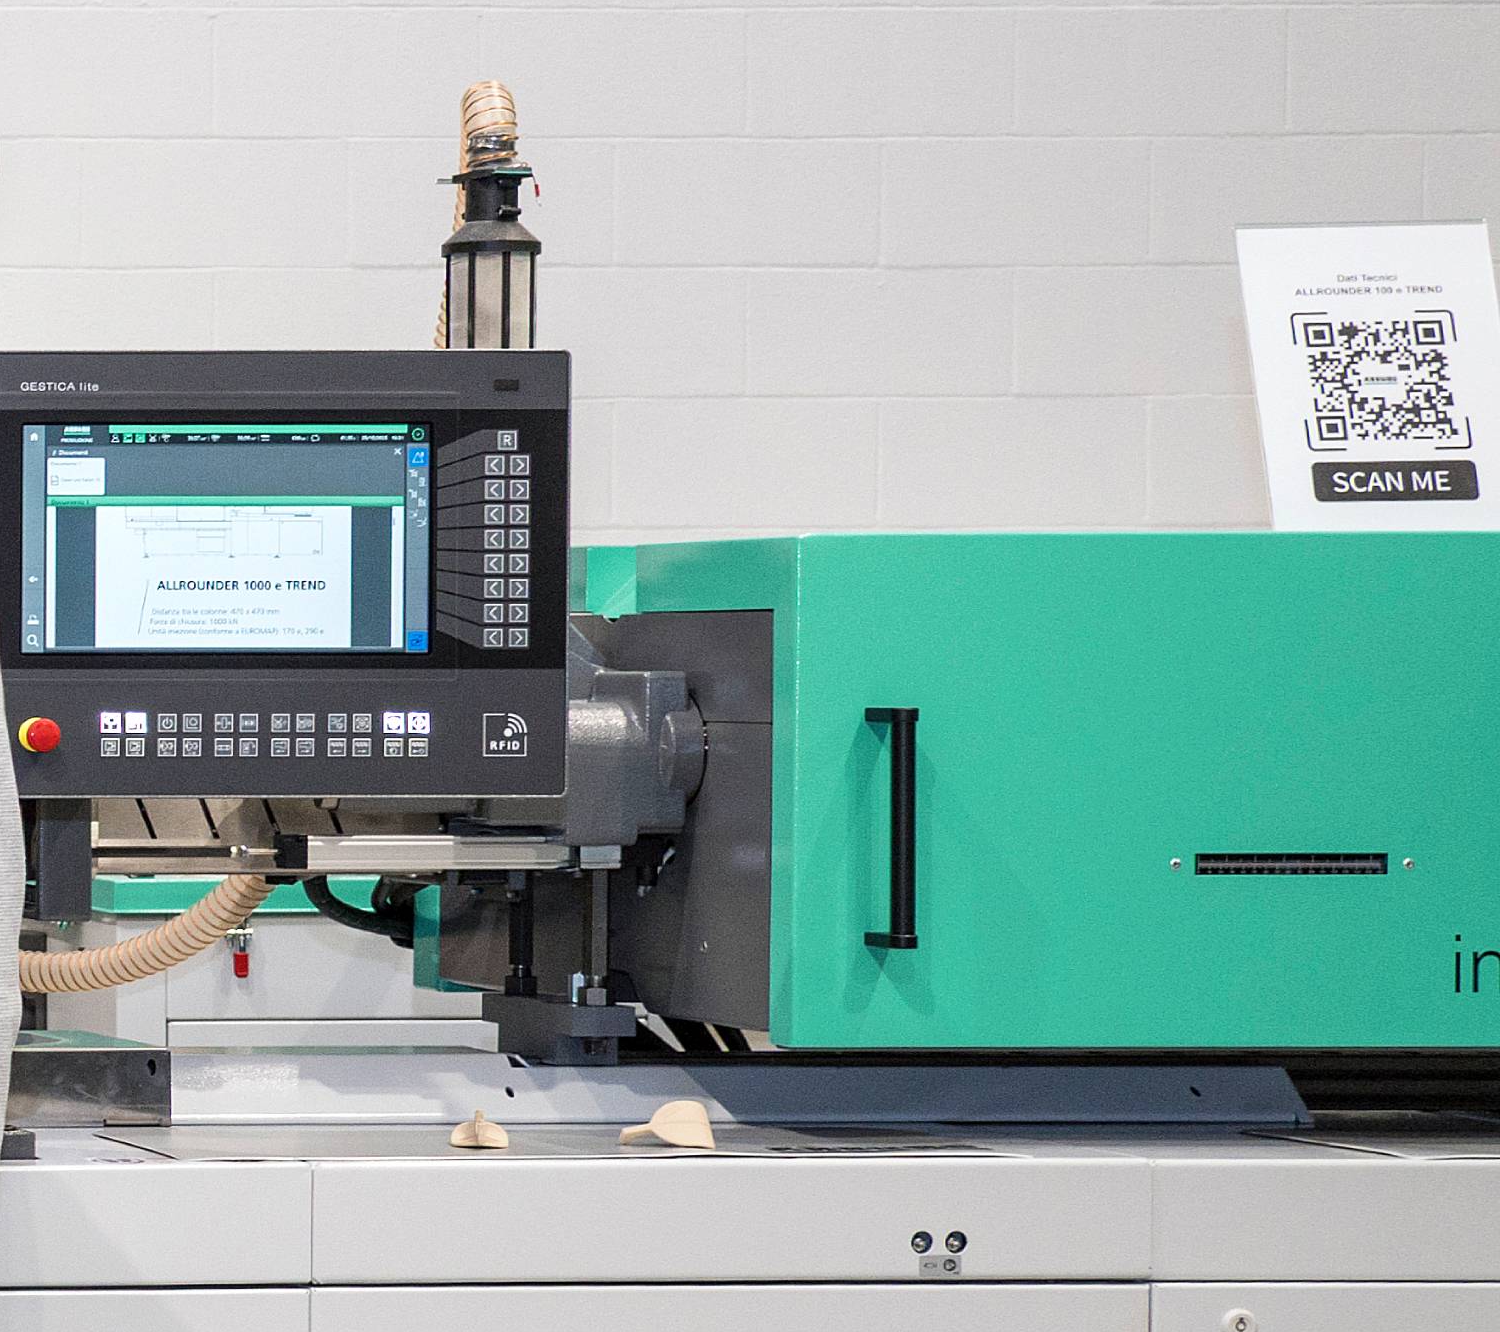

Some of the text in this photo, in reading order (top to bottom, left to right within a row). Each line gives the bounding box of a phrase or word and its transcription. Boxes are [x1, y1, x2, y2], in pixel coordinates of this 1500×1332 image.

[1295, 287, 1372, 296] ALLROUNDER
[1406, 285, 1443, 294] TREND
[20, 381, 99, 392] GESTICA lite
[1332, 470, 1452, 492] SCAN ME
[157, 580, 326, 591] ALLROUNDER 1000 e TREND
[490, 740, 520, 750] RFID
